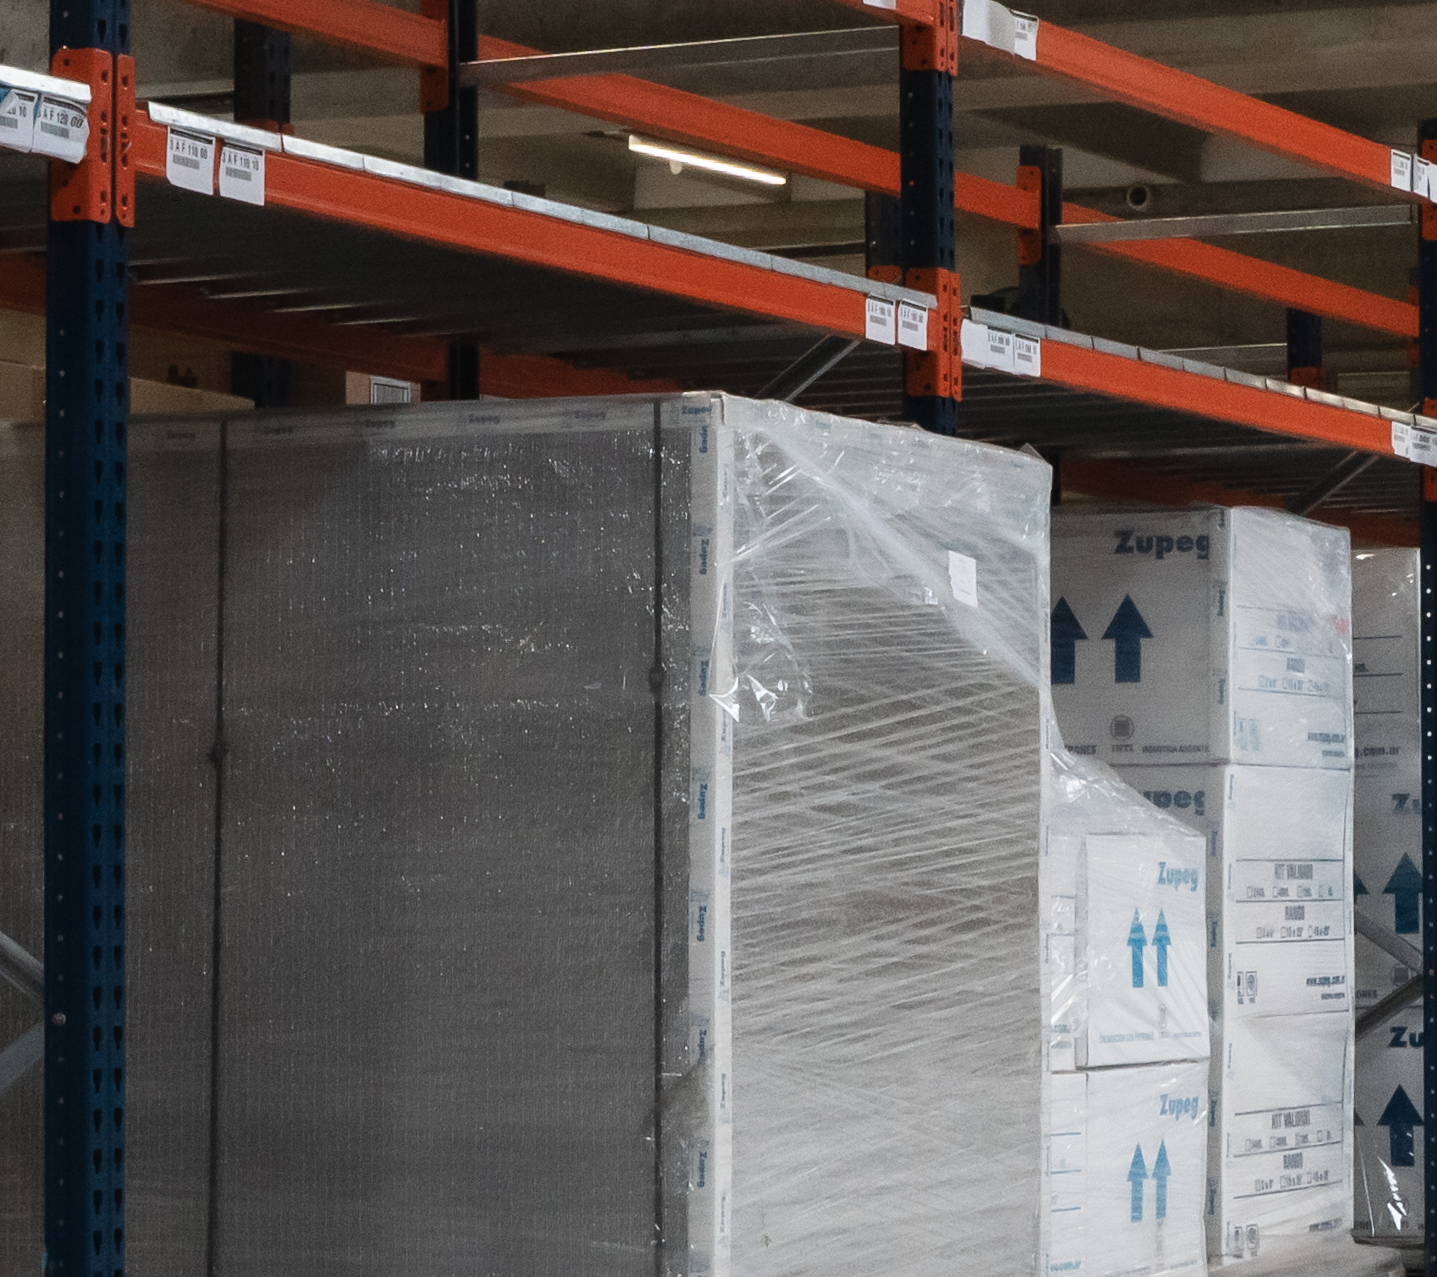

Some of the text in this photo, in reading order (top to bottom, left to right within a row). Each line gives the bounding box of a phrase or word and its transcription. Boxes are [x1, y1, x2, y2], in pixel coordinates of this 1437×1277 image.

[43, 108, 48, 119] A
[70, 116, 83, 128] 00
[176, 141, 180, 152] A
[227, 153, 232, 165] A
[1114, 530, 1210, 561] Zupeg
[1157, 861, 1199, 893] Zupeg
[697, 905, 707, 942] Zupeg
[1159, 1093, 1200, 1122] Zupeg
